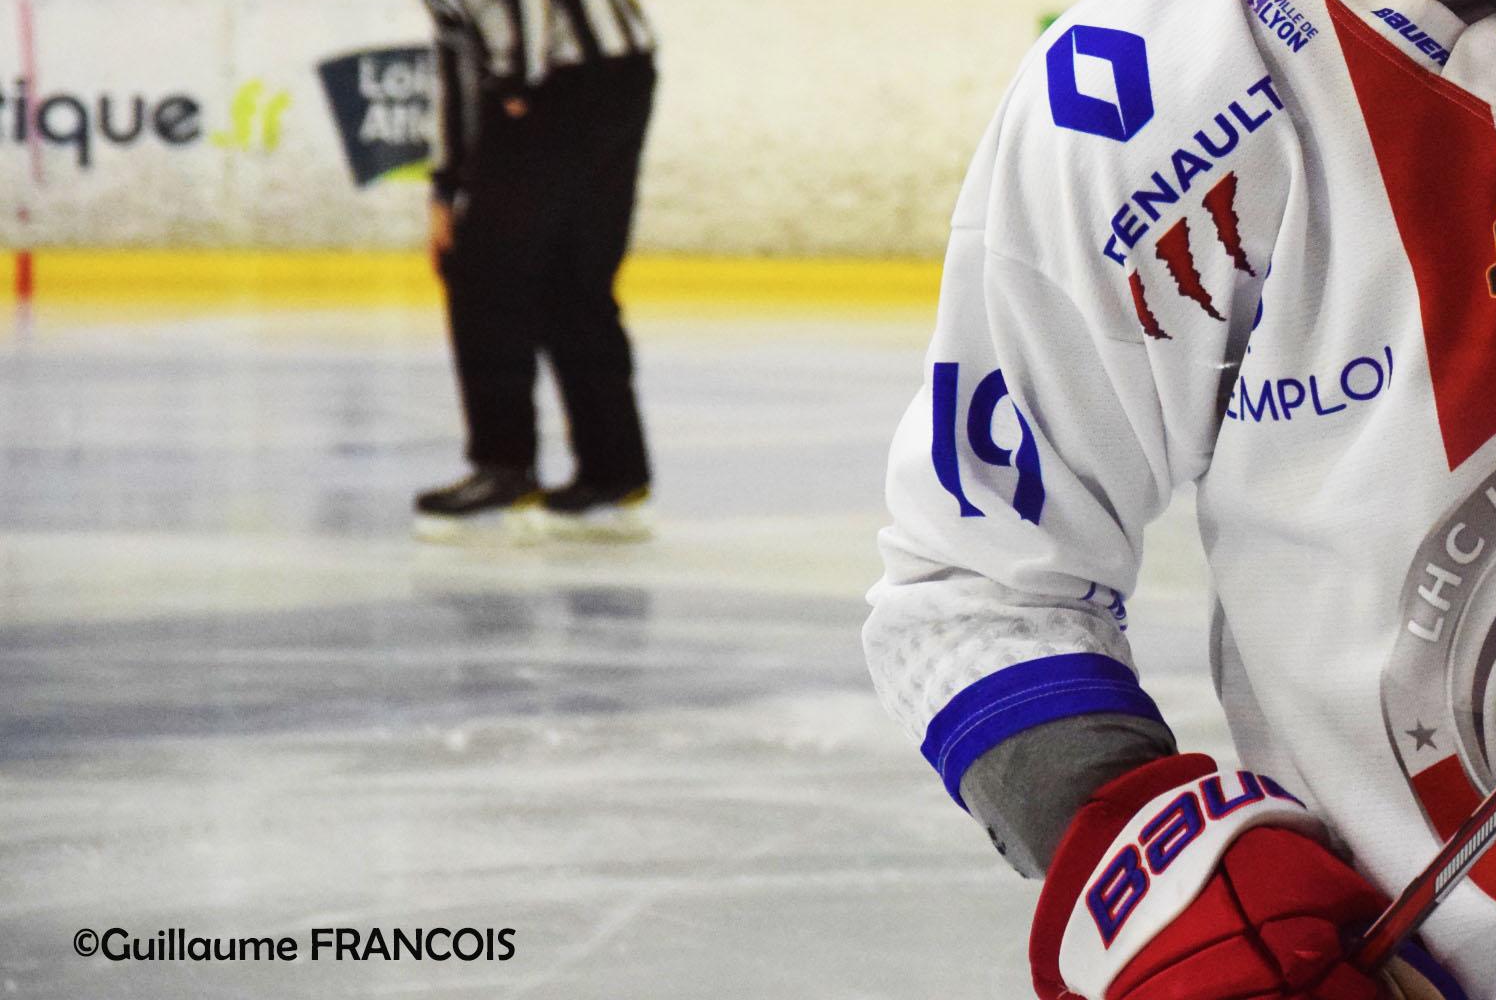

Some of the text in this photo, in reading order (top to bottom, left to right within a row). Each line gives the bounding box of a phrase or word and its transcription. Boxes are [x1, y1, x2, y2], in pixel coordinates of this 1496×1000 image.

[1258, 2, 1309, 53] LYON
[1300, 20, 1319, 40] DE
[931, 362, 1046, 526] 19
[1406, 522, 1486, 644] LHC
